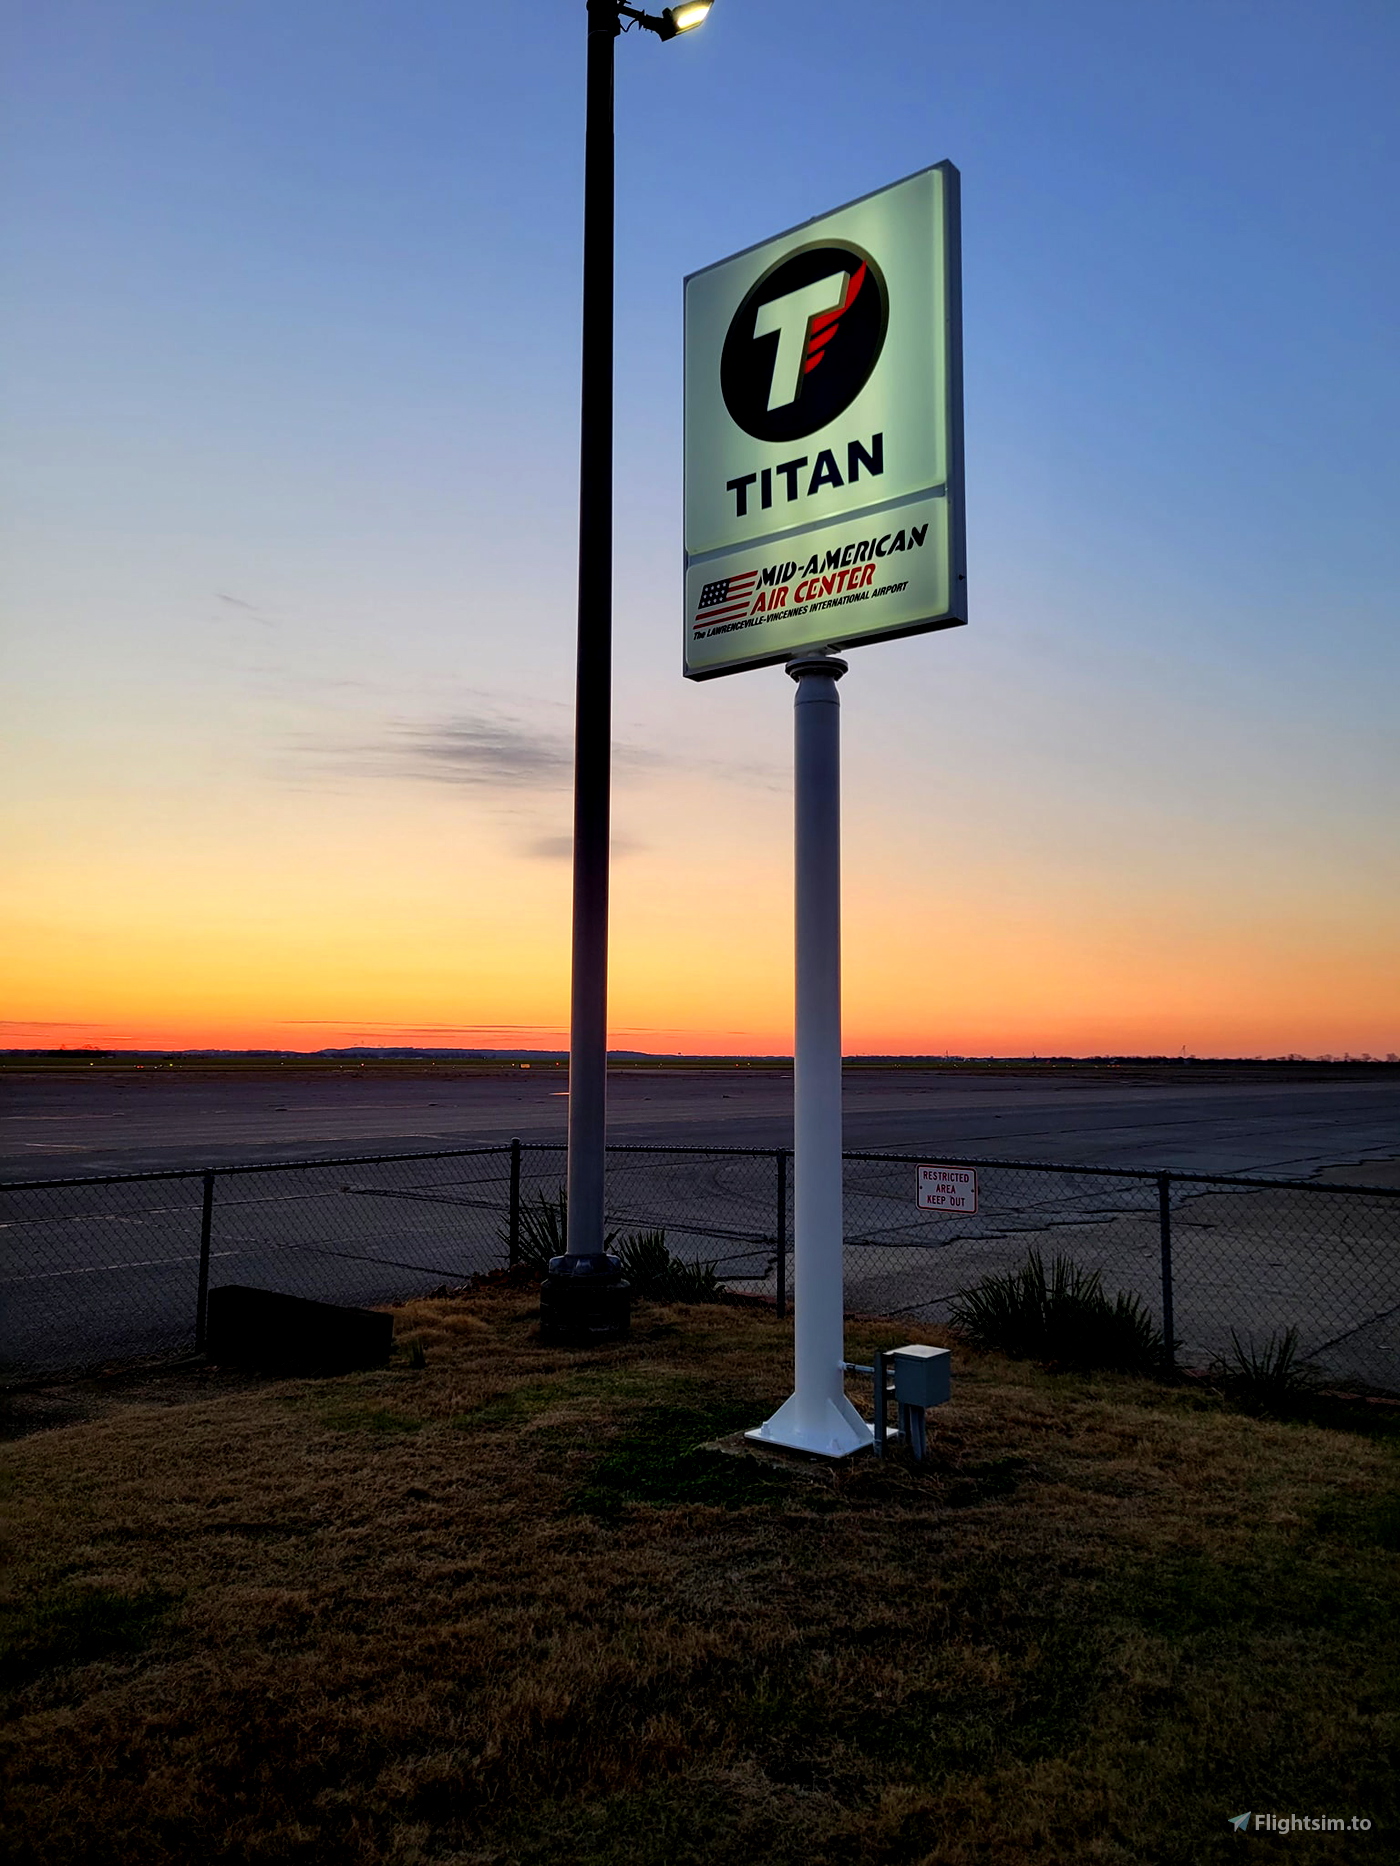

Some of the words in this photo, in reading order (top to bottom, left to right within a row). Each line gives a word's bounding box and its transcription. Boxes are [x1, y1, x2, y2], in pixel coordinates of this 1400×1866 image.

[726, 432, 884, 517] TITAN
[756, 523, 929, 590] MID-AMERICAN
[706, 605, 808, 637] LAWRENCEVILLE-VINCENNES
[809, 591, 870, 613] INTERNATIONAL
[871, 581, 909, 599] AIRPORT
[750, 586, 788, 616] AIR
[793, 563, 877, 604] CENTER
[923, 1171, 969, 1182] RESTRICTED
[927, 1195, 946, 1204] KEEP
[950, 1196, 965, 1207] OUT
[936, 1184, 956, 1193] AREA
